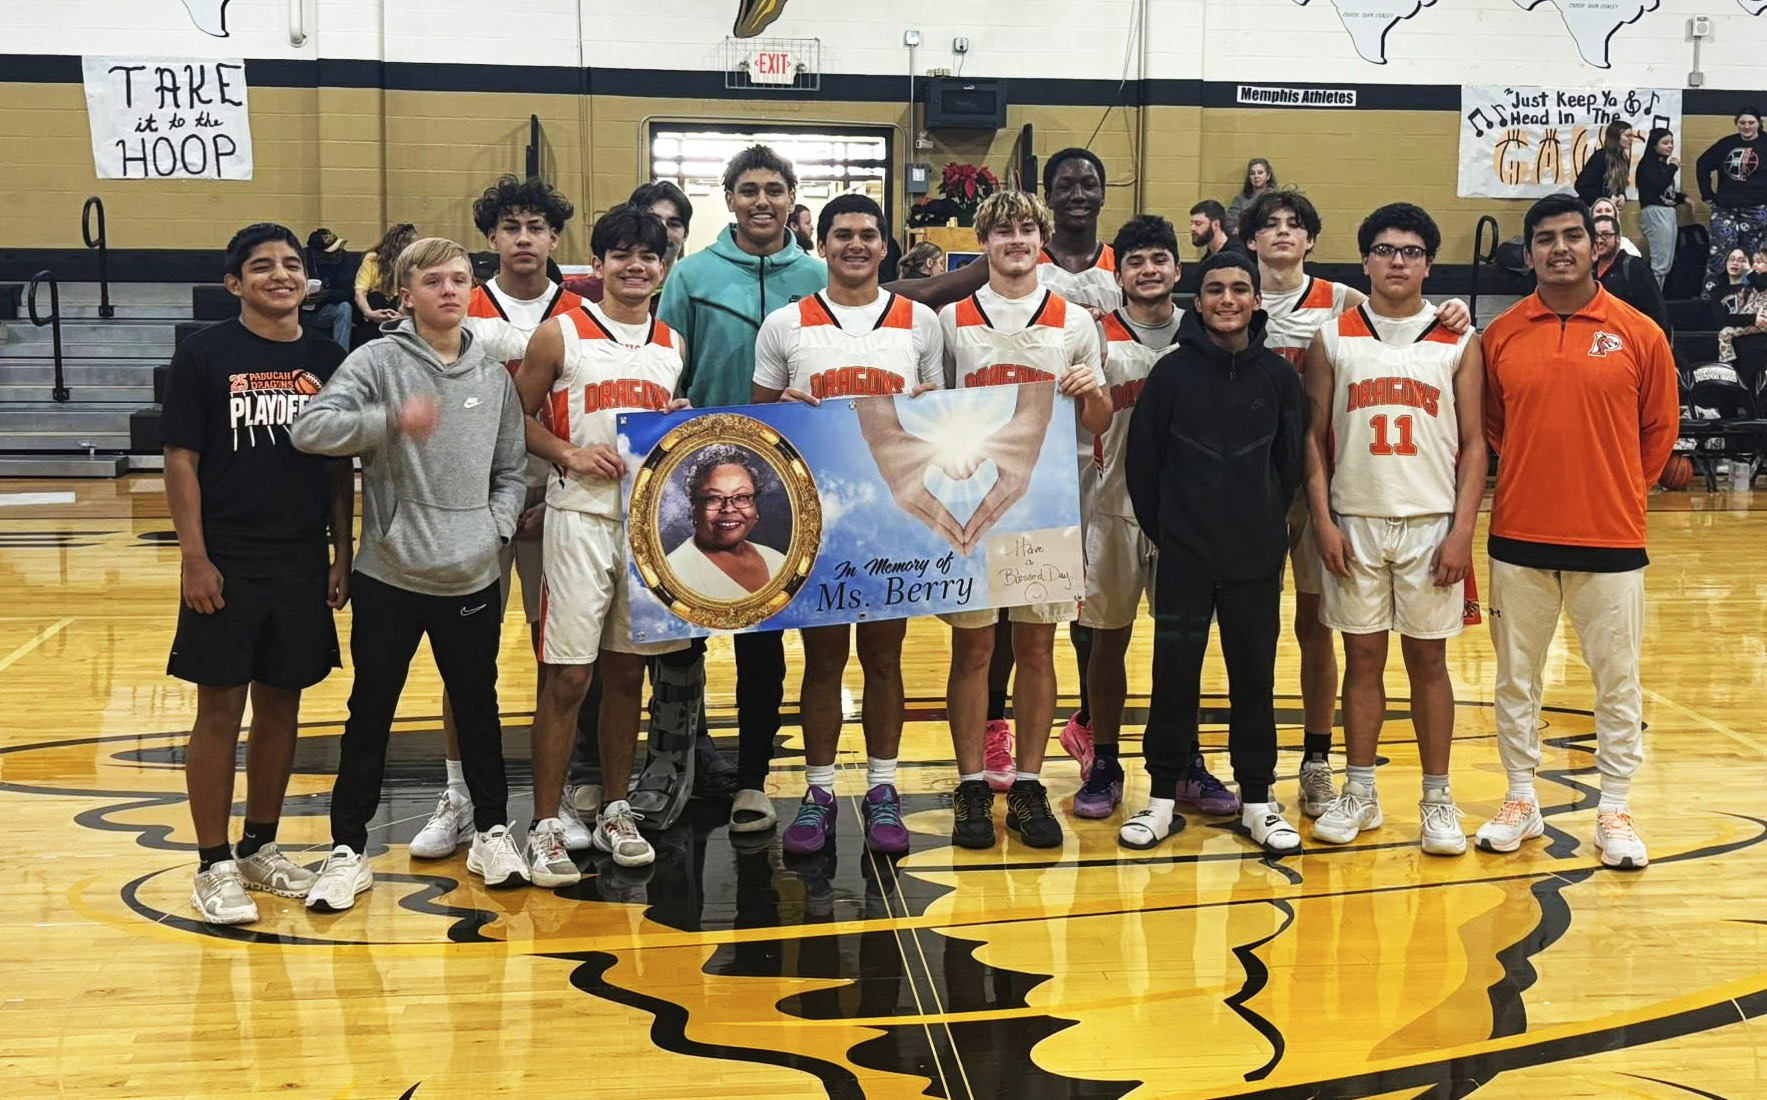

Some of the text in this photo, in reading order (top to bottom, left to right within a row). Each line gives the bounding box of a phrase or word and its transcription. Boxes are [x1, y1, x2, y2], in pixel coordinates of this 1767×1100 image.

[759, 53, 789, 74] EXIT
[108, 63, 243, 109] TAKE
[1240, 86, 1354, 105] Memphis Athletes
[1511, 89, 1618, 115] Just Keep Ya
[135, 110, 225, 133] it to the
[1510, 107, 1621, 126] Head In The
[115, 133, 237, 178] HOOP
[249, 371, 291, 381] PADUCAH
[250, 380, 294, 390] DRAGONS
[809, 366, 905, 399] DRAGONS
[584, 378, 671, 414] DRAGON
[1346, 376, 1441, 418] DRAGONS
[1368, 414, 1418, 456] 11
[1015, 536, 1045, 557] Have
[834, 551, 955, 580] In Memory of
[998, 567, 1045, 587] Blessed
[816, 575, 974, 612] Ms. Berry
